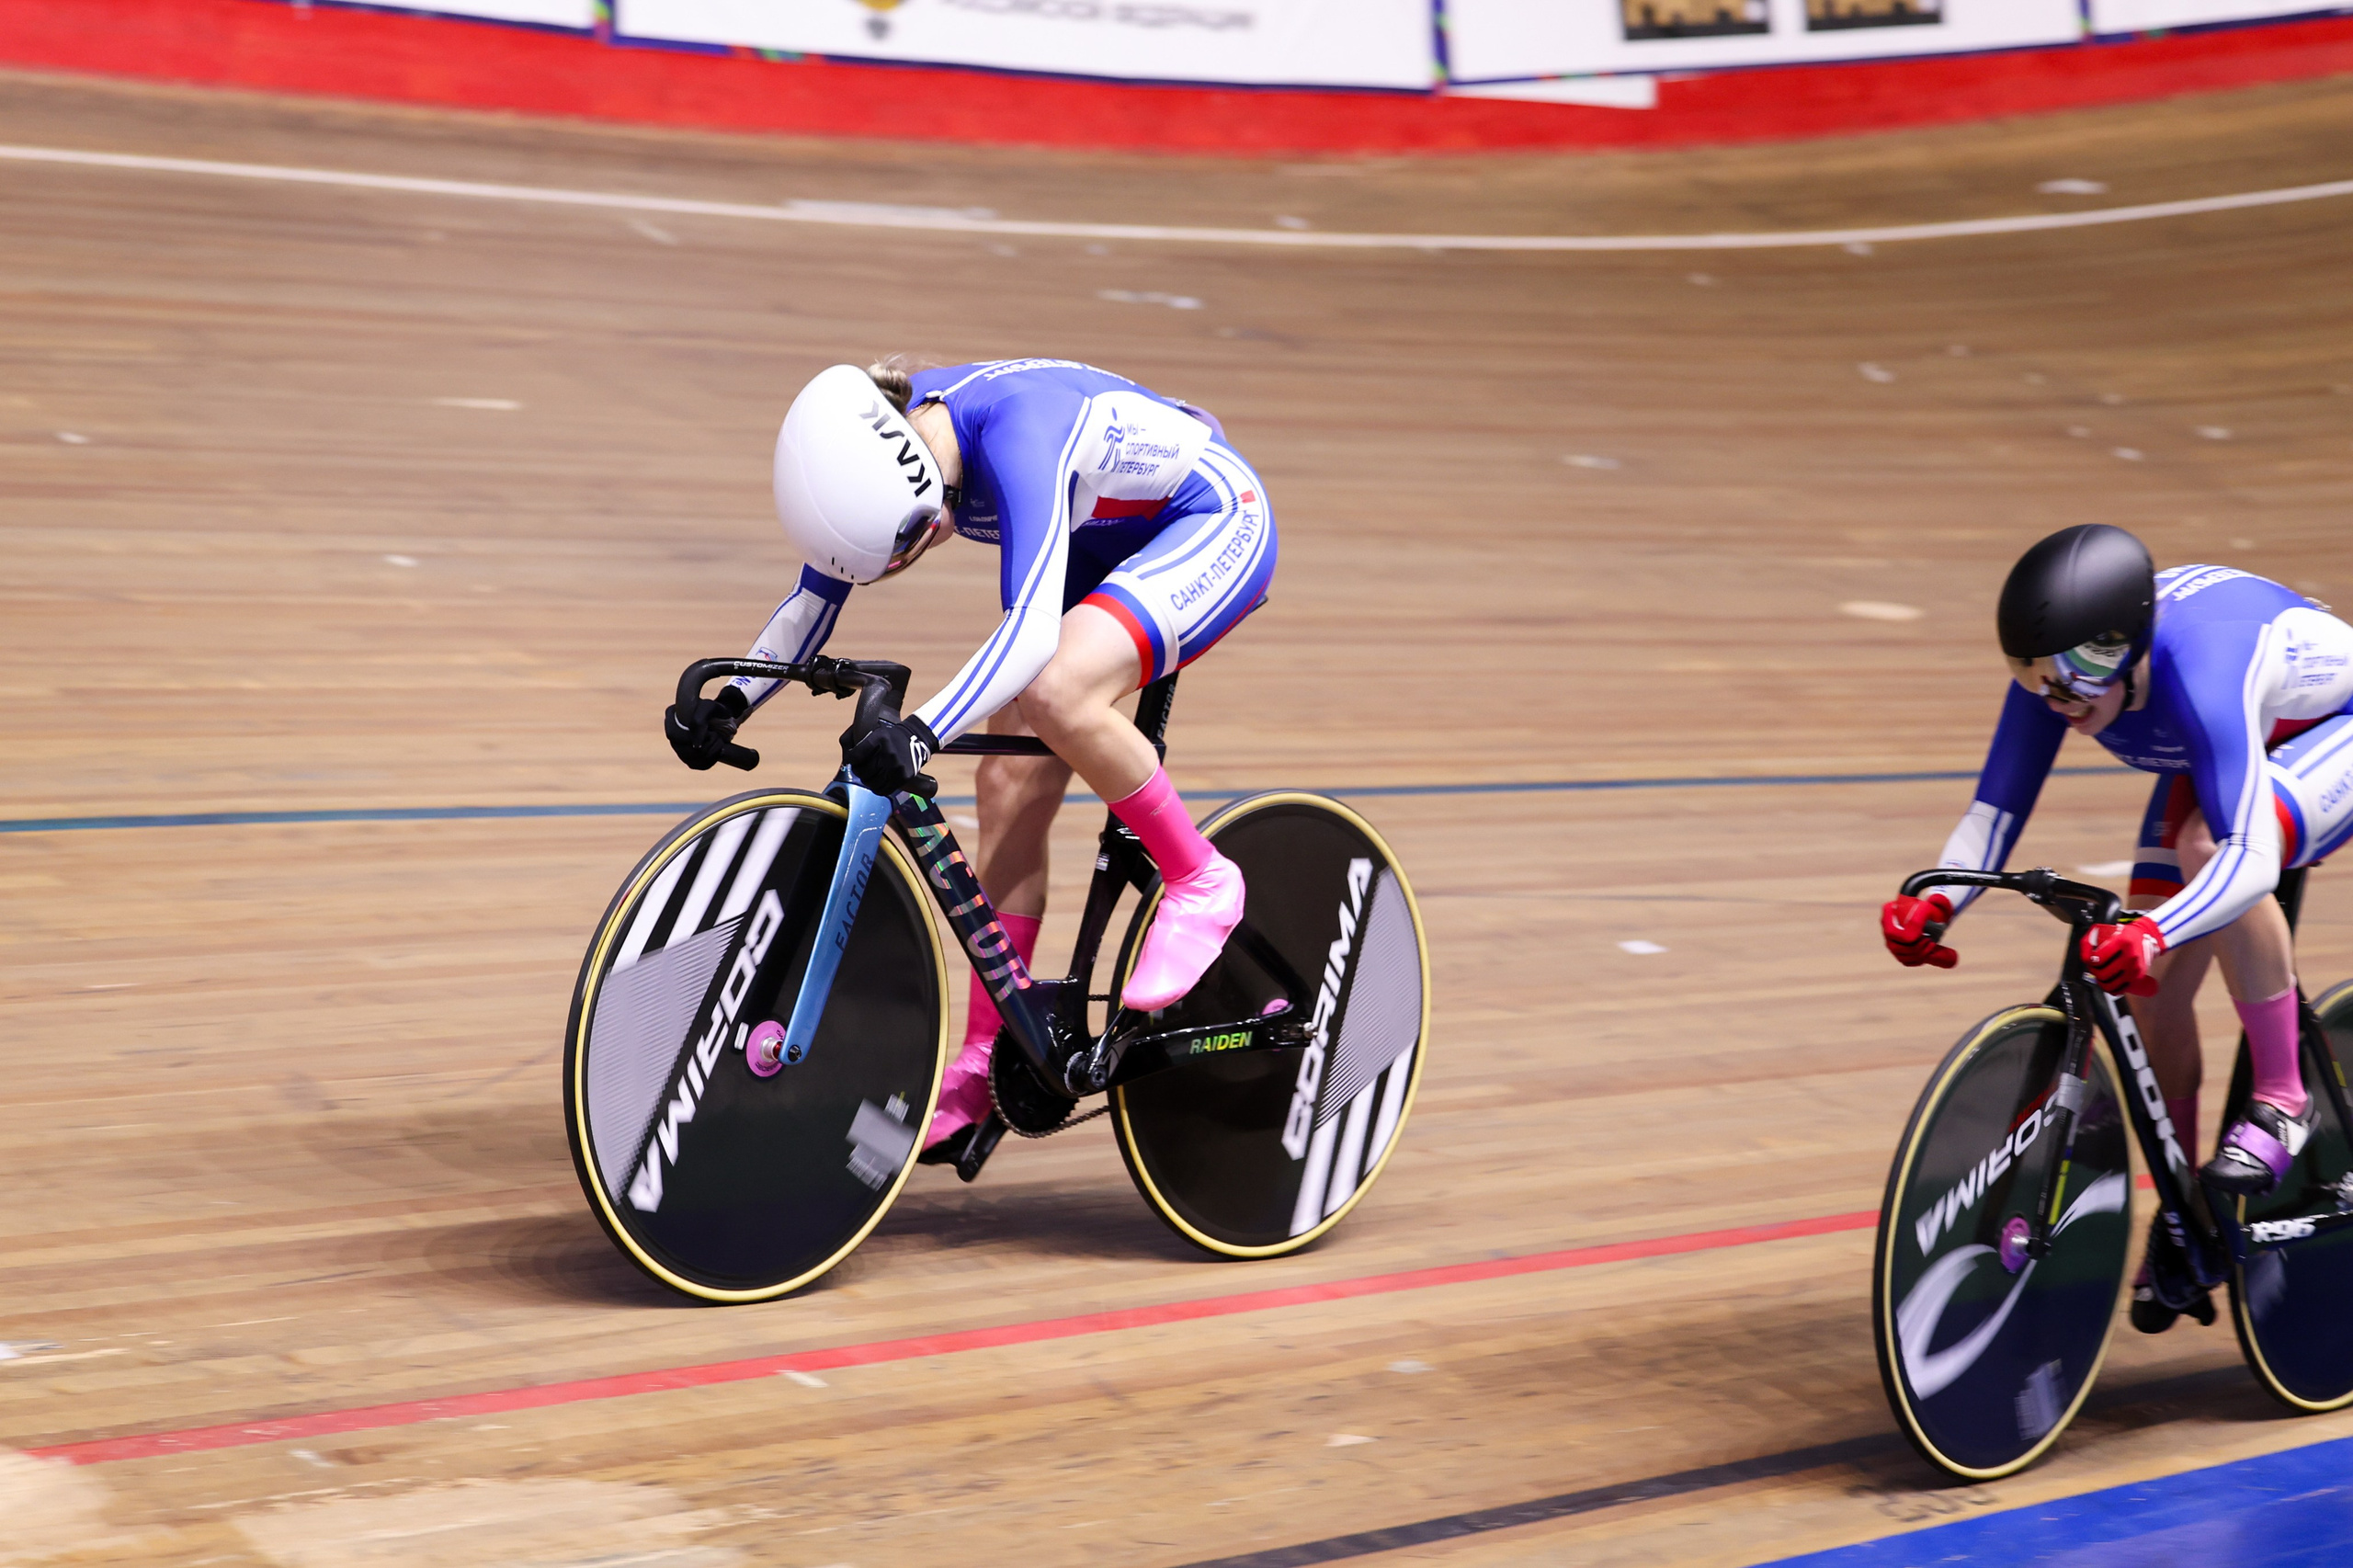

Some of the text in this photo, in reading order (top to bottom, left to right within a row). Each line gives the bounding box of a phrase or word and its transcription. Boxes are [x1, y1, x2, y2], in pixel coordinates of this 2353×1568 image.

[858, 400, 932, 498] KASK
[1126, 442, 1180, 460] СПОРТИВНЫЙ
[1170, 509, 1259, 611] САНКТ-ПЕТЕРБУРГ
[733, 660, 790, 671] CUSTOMIZER
[835, 852, 873, 953] FACTOR
[627, 888, 785, 1213] CORIMA
[1188, 1030, 1254, 1055] RAIDEN
[1281, 857, 1374, 1161] CORIMA
[2102, 991, 2189, 1175] LOOK
